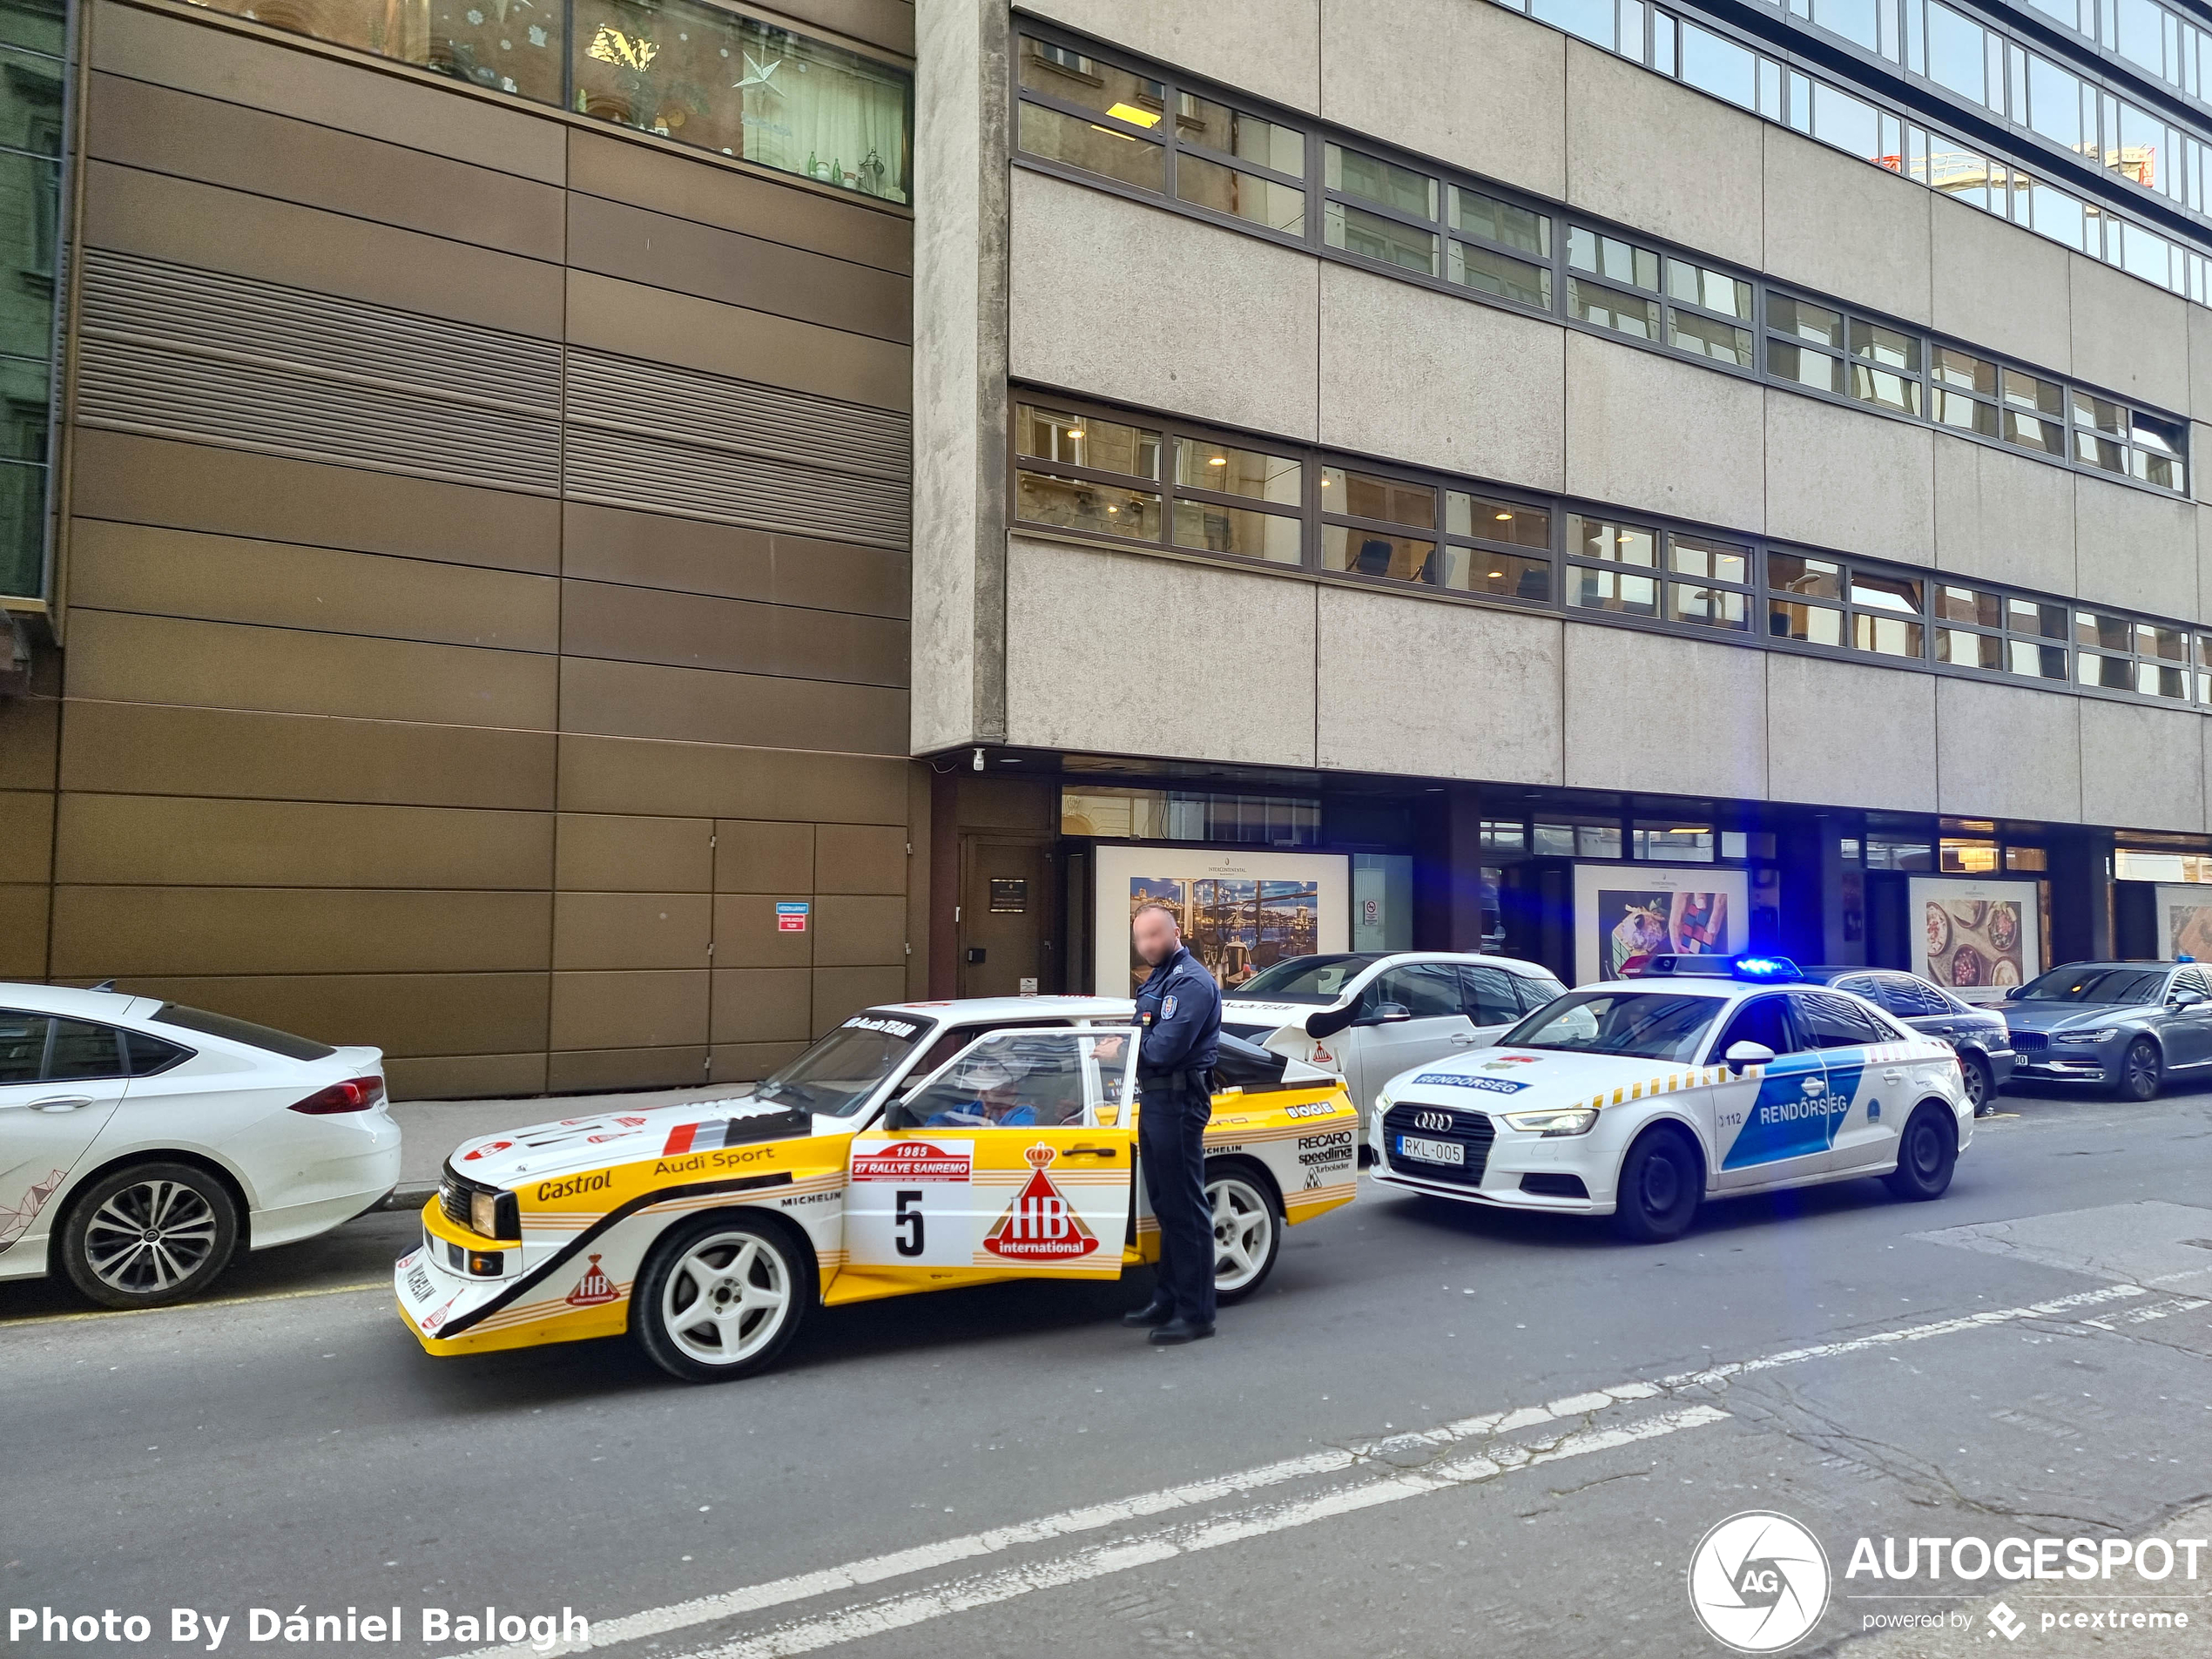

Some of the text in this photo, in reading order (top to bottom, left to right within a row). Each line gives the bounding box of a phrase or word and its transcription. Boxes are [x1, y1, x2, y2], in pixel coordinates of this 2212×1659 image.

[880, 1020, 917, 1037] TEAM
[1417, 1075, 1518, 1094] RENDŐRSÉG
[1286, 1102, 1334, 1119] BOGE
[1760, 1093, 1848, 1125] RENDŐRSÉG
[1298, 1131, 1352, 1150] RECARO
[896, 1146, 928, 1157] 1985
[1204, 1144, 1242, 1156] ICHELIN
[1298, 1147, 1352, 1164] speedline
[1405, 1139, 1460, 1162] RKL-005
[653, 1147, 775, 1176] Audi Sport
[853, 1163, 968, 1174] 27 RALLYE SANREMO
[1315, 1163, 1350, 1174] Turbolader
[537, 1170, 612, 1202] Castrol
[781, 1191, 842, 1207] MICHELIN
[895, 1190, 924, 1257] 5
[1011, 1196, 1069, 1239] HB
[999, 1240, 1084, 1253] international
[578, 1275, 609, 1297] HB
